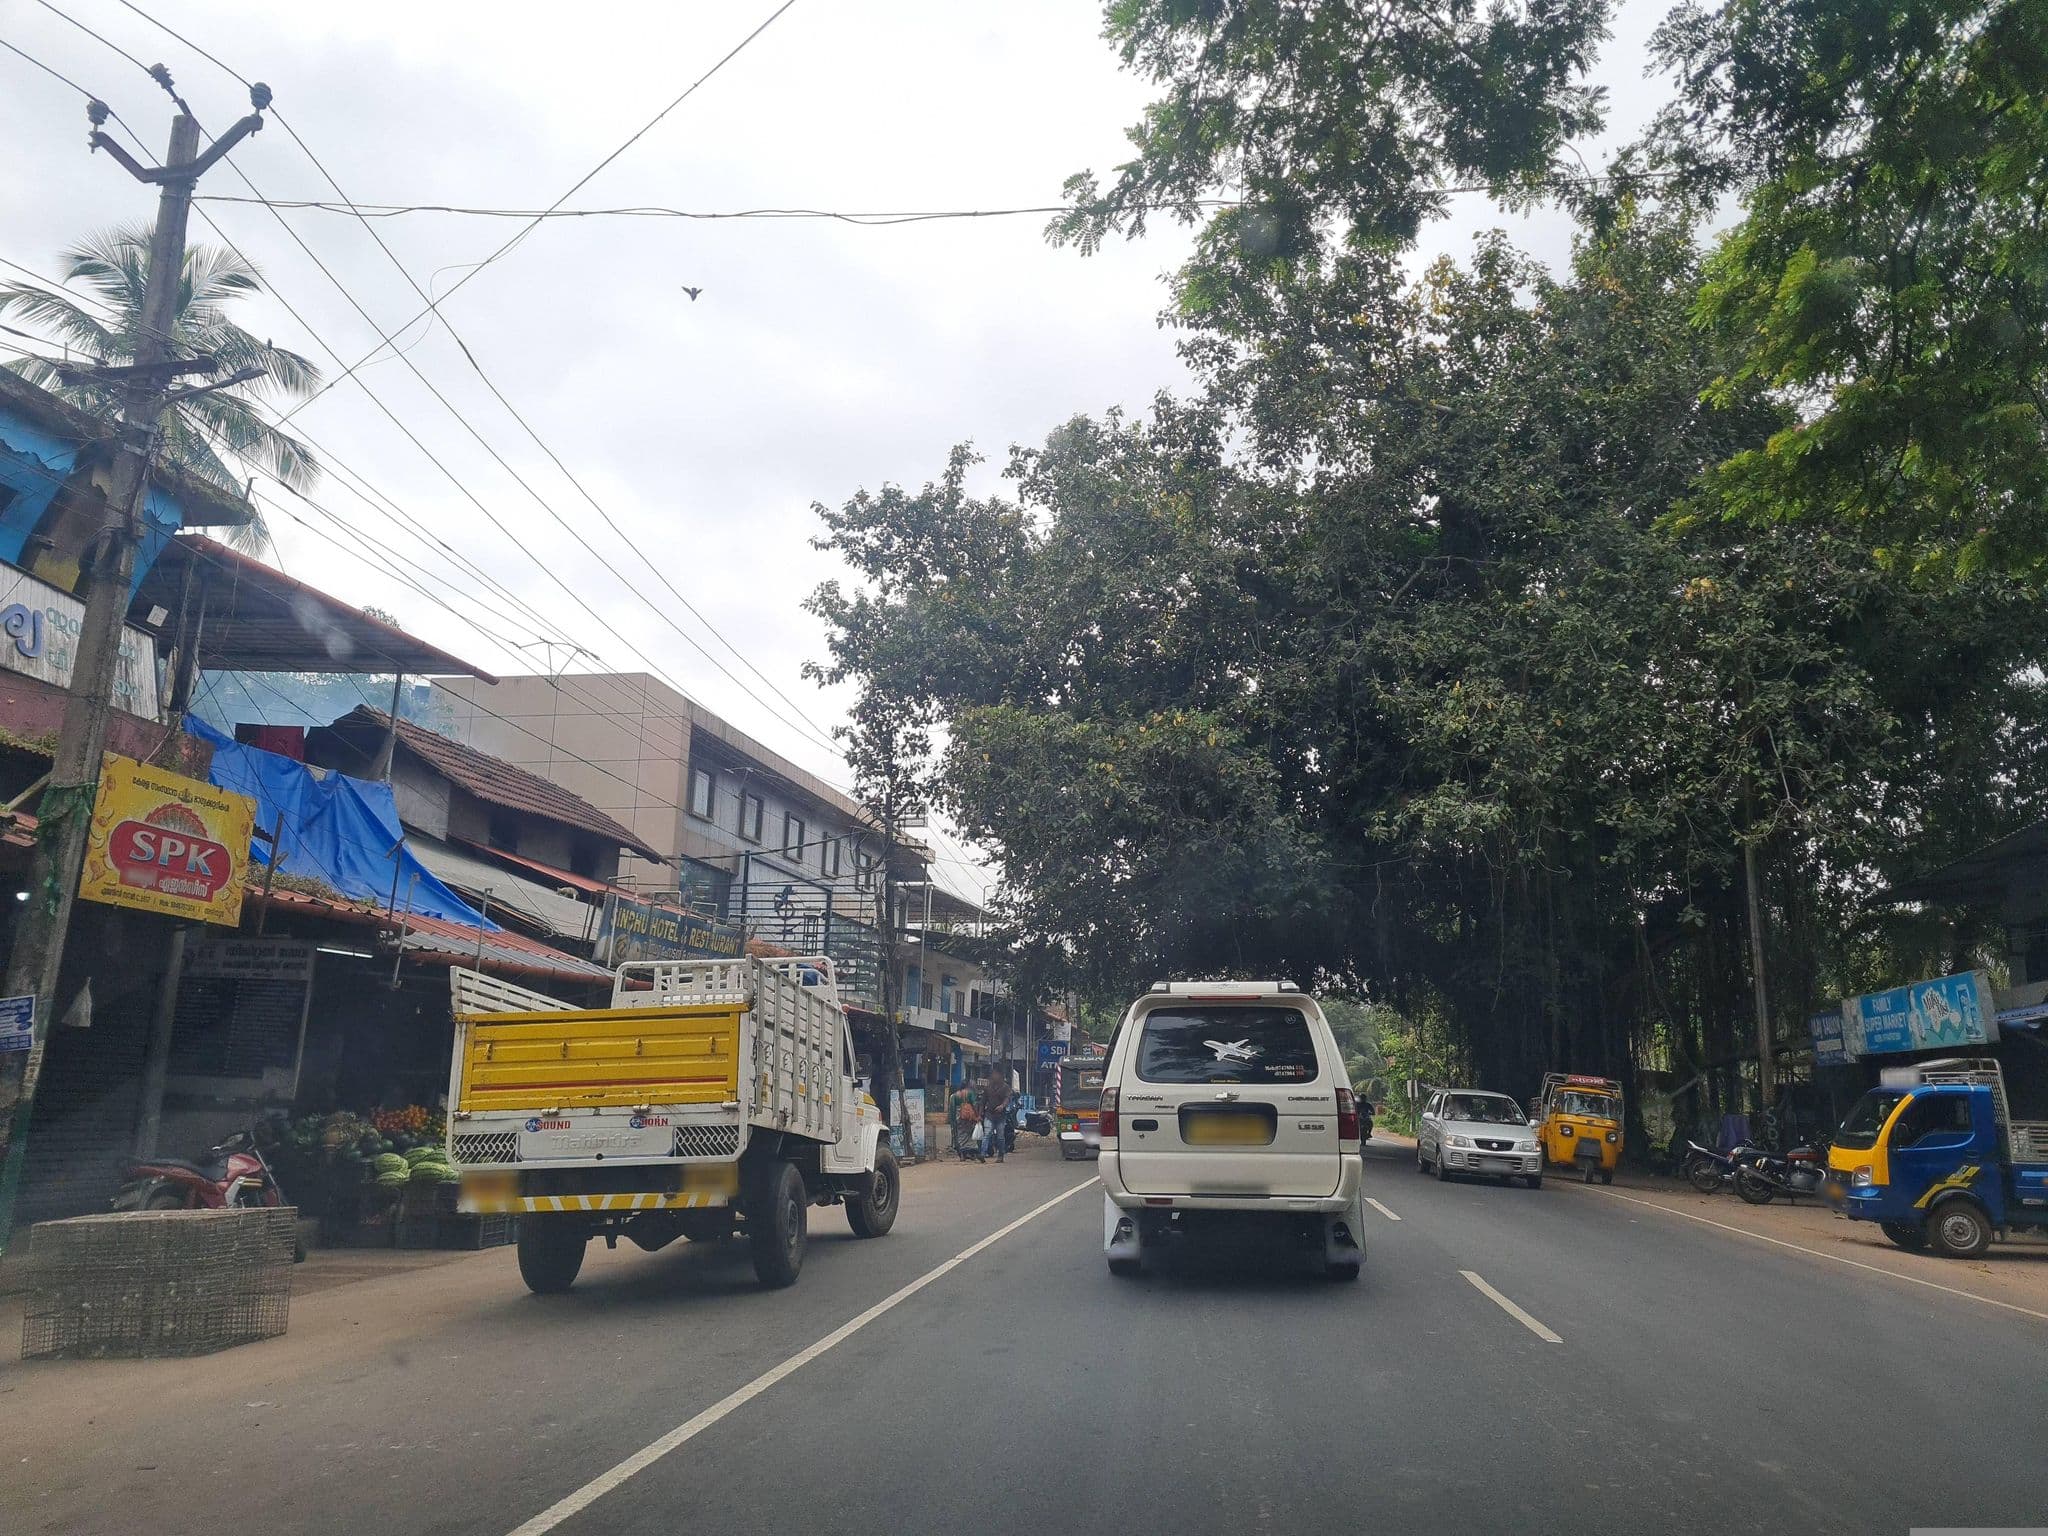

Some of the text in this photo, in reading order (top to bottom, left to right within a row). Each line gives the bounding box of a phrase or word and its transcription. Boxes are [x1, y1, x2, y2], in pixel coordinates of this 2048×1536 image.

[129, 830, 216, 877] SPK
[649, 916, 679, 942] HOTEL
[688, 927, 738, 955] RESTAURANT
[537, 1120, 571, 1130] SOUND
[641, 1115, 669, 1127] HORN
